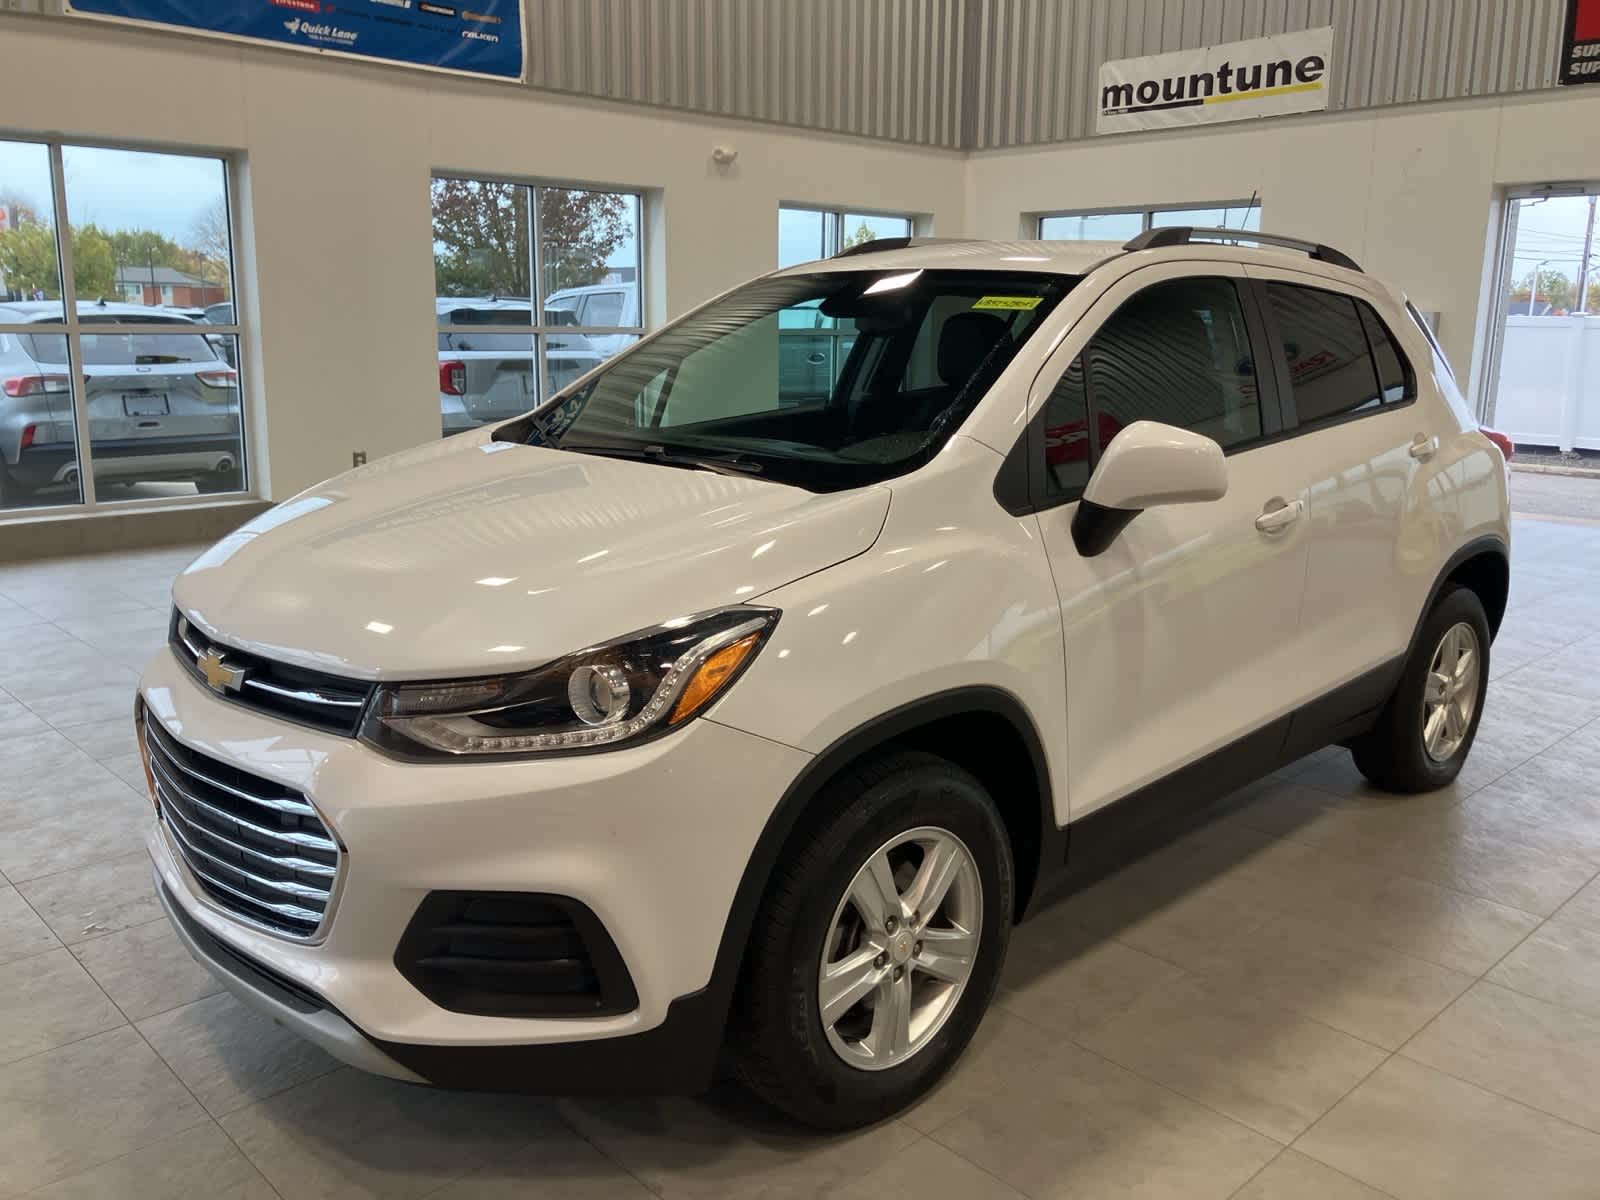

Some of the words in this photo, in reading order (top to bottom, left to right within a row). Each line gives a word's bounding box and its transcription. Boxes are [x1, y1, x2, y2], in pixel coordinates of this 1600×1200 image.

[300, 22, 331, 36] Quick
[331, 27, 359, 40] Lane
[1102, 55, 1325, 109] mountune
